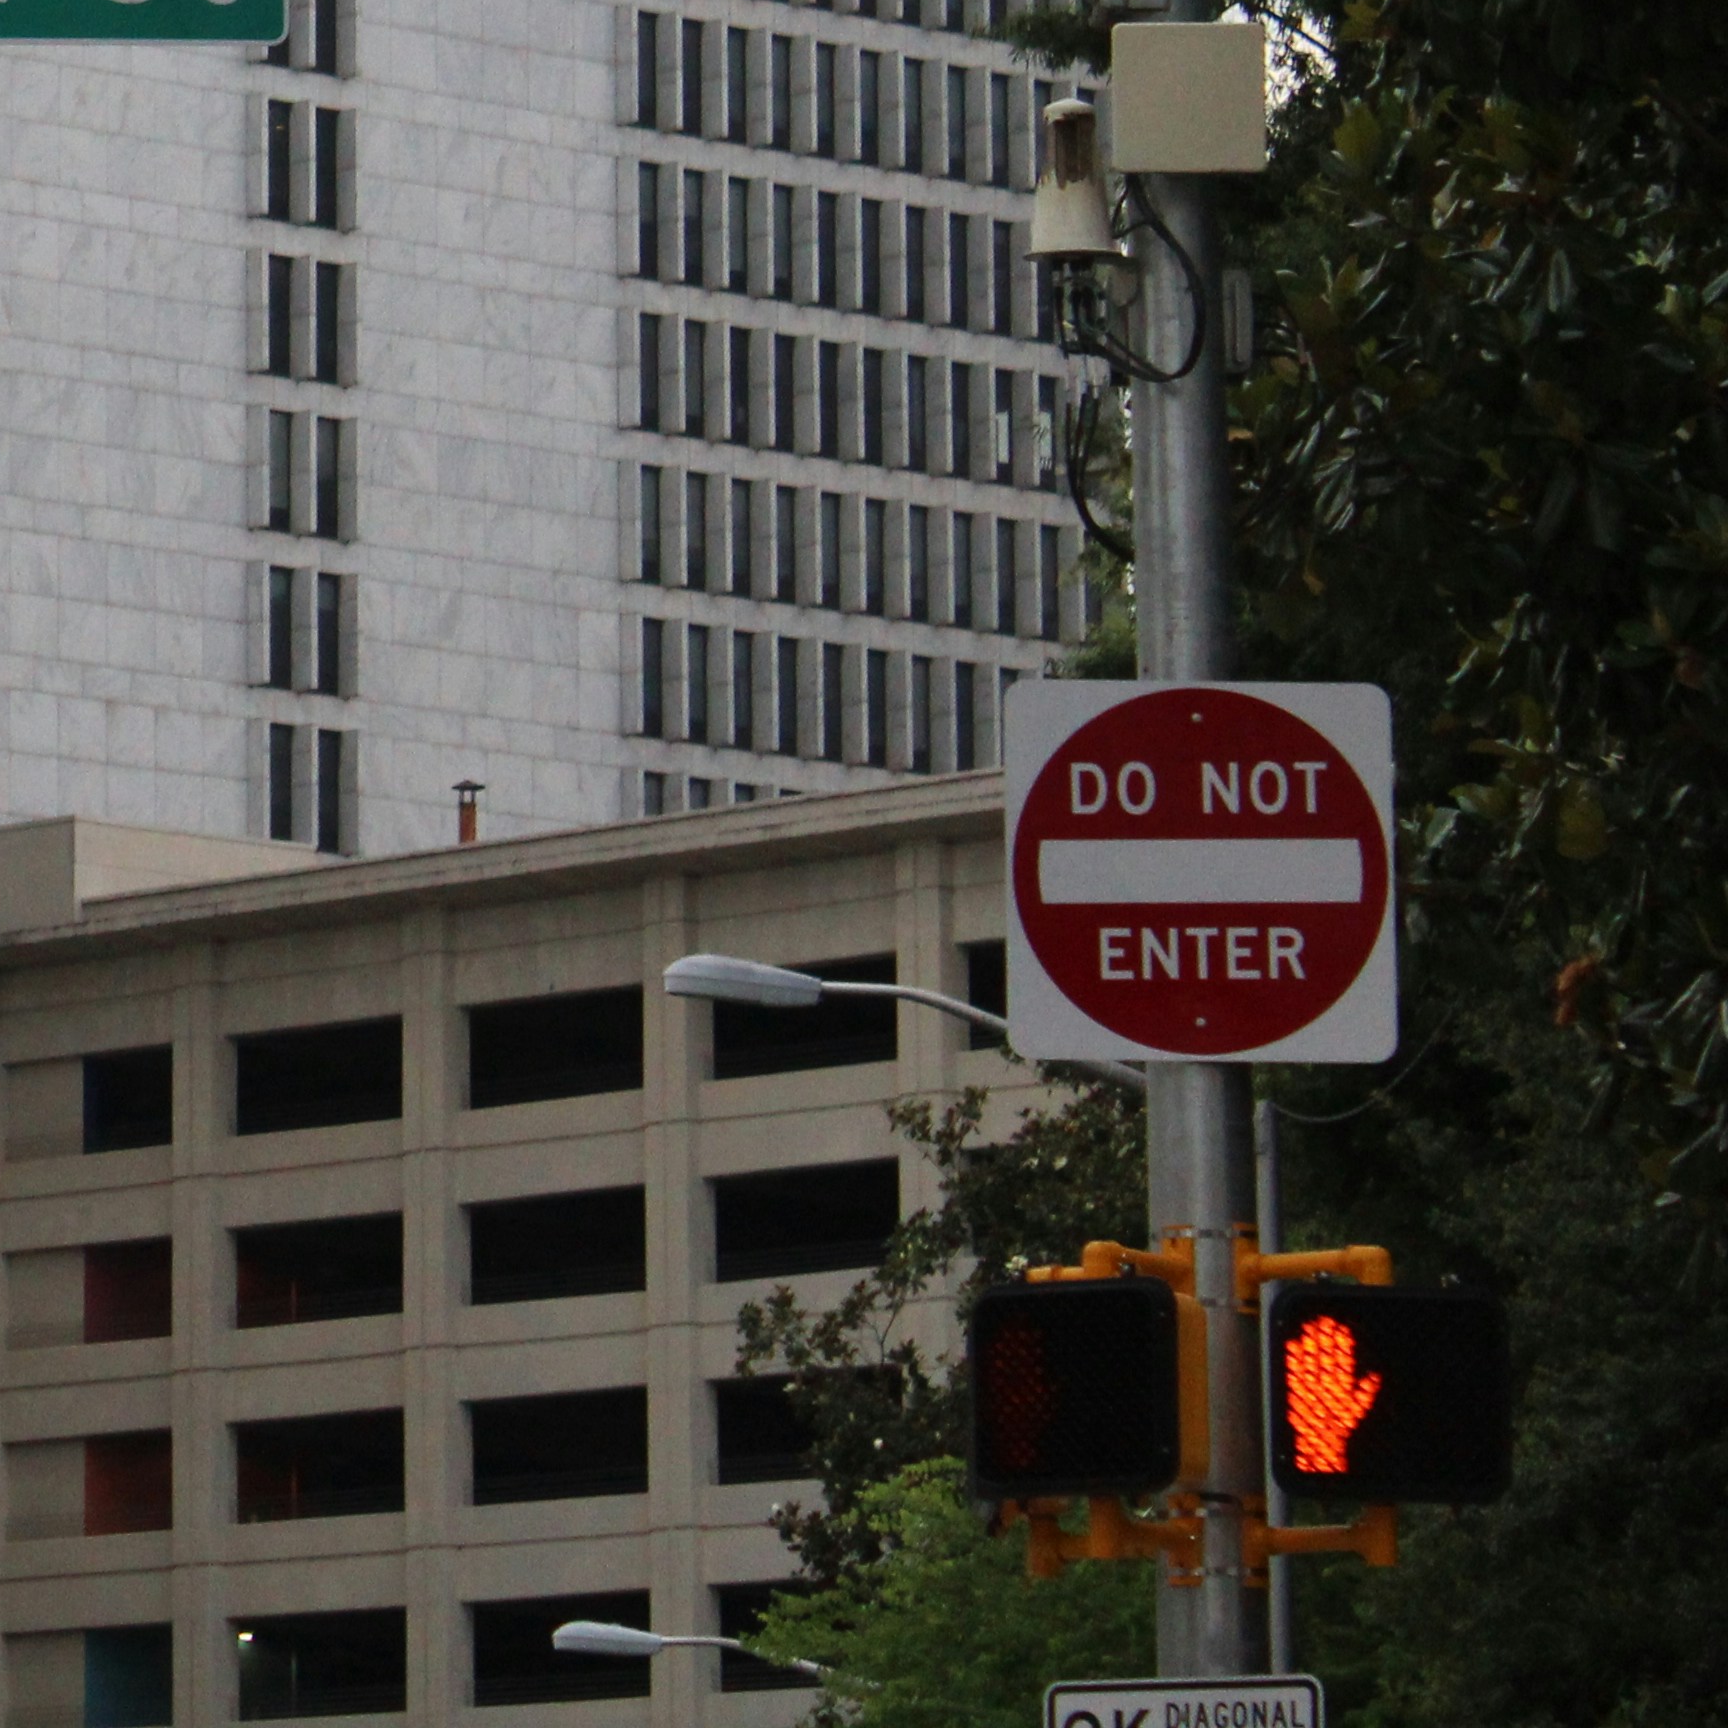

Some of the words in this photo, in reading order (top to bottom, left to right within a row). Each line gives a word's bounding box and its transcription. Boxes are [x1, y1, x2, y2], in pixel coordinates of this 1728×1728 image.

[1069, 761, 1157, 816] DO
[1201, 761, 1328, 815] NOT
[1098, 927, 1307, 981] ENTER
[1164, 1700, 1305, 1728] DIAGONAL
